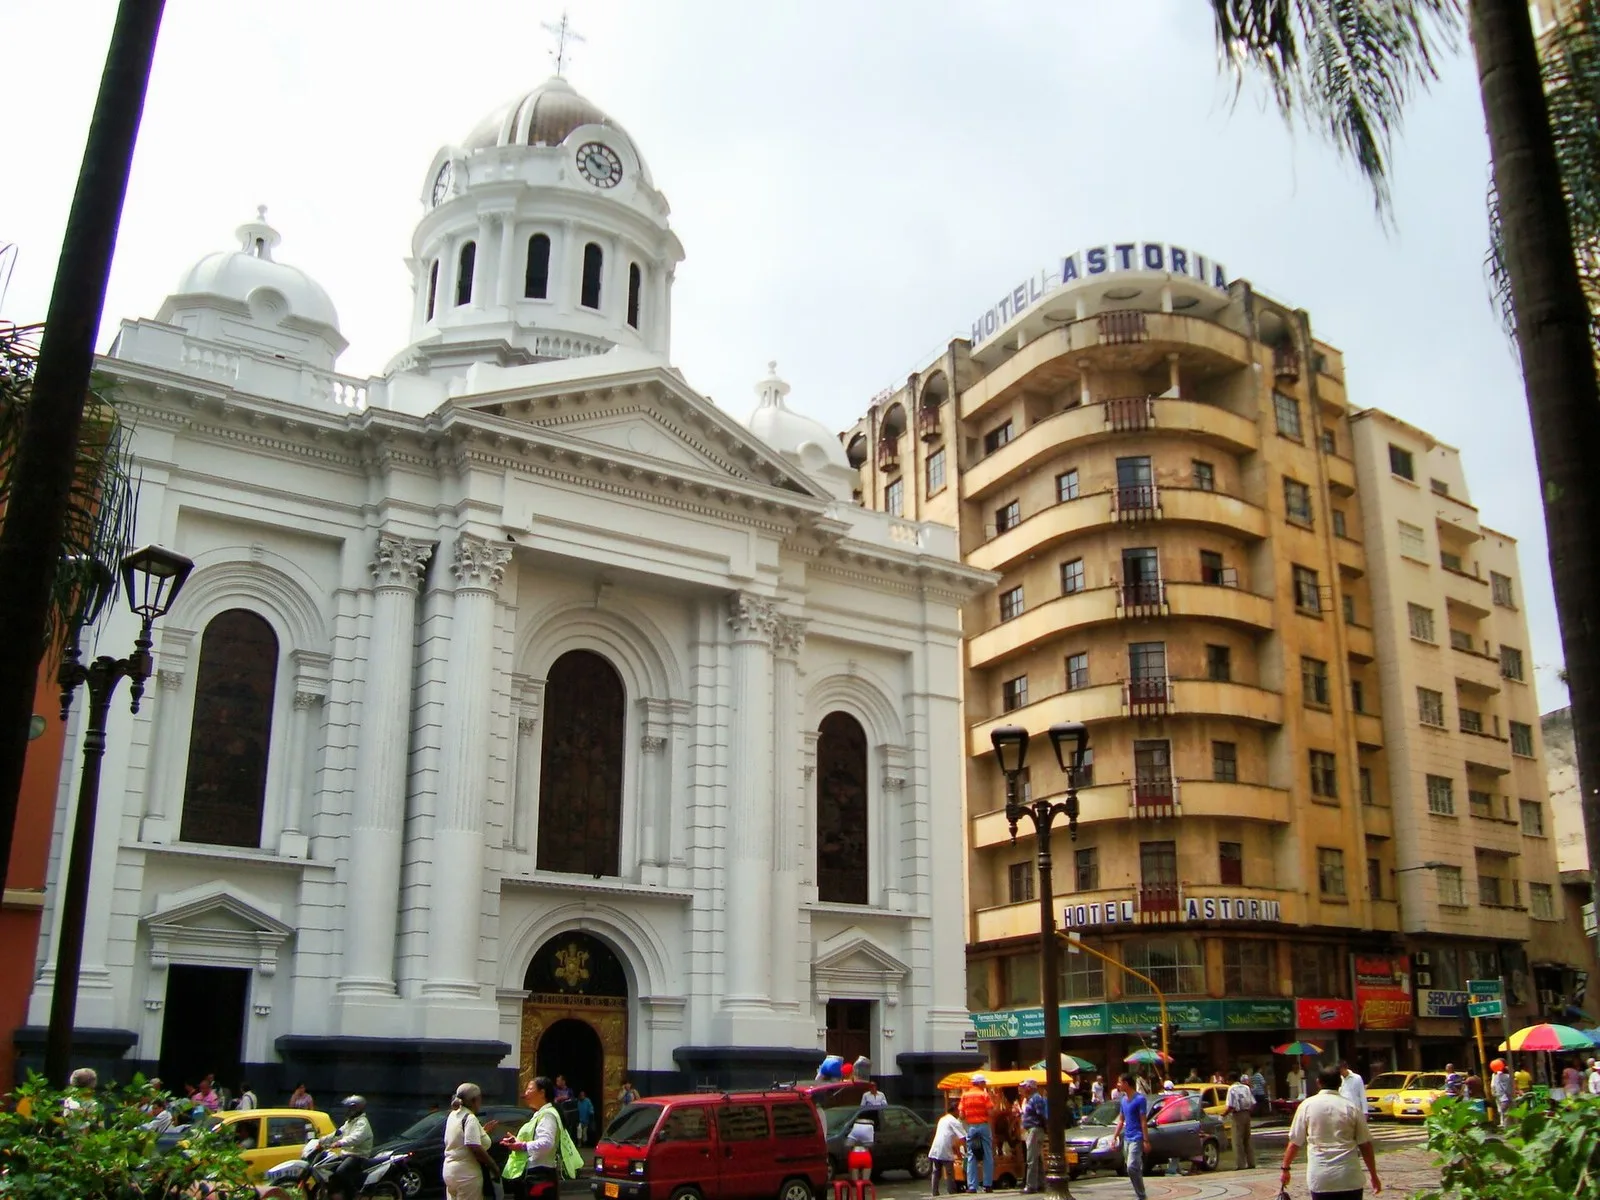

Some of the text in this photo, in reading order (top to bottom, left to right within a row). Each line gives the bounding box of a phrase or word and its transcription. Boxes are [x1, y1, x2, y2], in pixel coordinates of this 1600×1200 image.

[971, 243, 1229, 347] HOTEL ASTORIA
[1064, 898, 1281, 927] HOTEL ASTORIA
